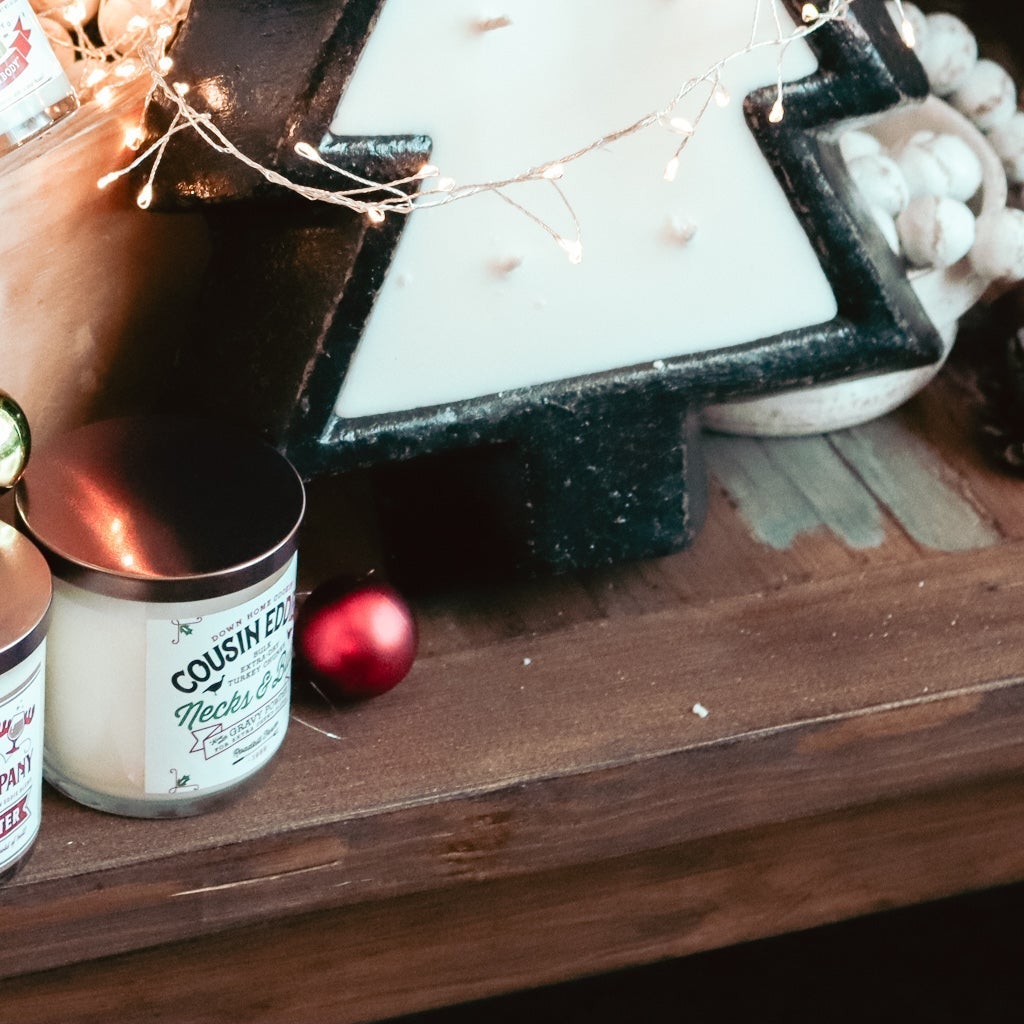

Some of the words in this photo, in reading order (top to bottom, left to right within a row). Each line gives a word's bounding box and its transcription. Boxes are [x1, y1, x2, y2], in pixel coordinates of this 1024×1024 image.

[211, 619, 242, 642] DOWN
[247, 598, 272, 620] HOME
[171, 618, 261, 694] COUSIN
[175, 690, 254, 730] Necks
[257, 671, 273, 699] &
[229, 710, 264, 737] GRAVY
